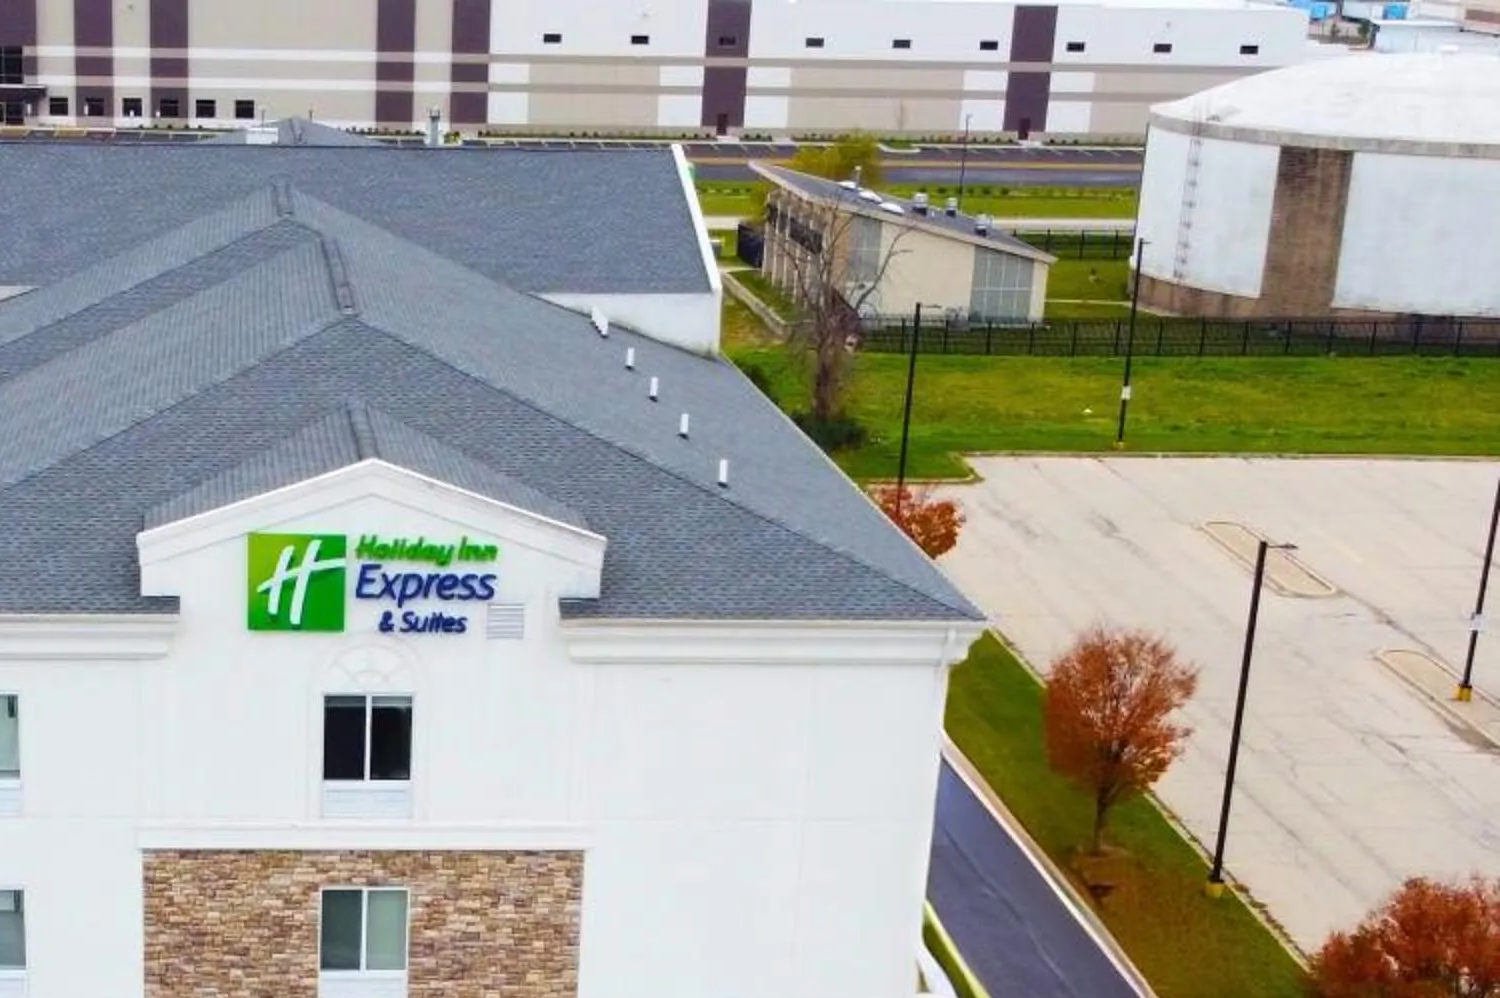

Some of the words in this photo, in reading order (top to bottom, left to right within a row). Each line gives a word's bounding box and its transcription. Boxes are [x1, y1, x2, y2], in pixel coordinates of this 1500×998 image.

[356, 535, 454, 566] Holiday
[458, 536, 497, 560] Inn
[356, 564, 497, 608] Express
[379, 611, 394, 632] &
[400, 611, 467, 633] Suites
